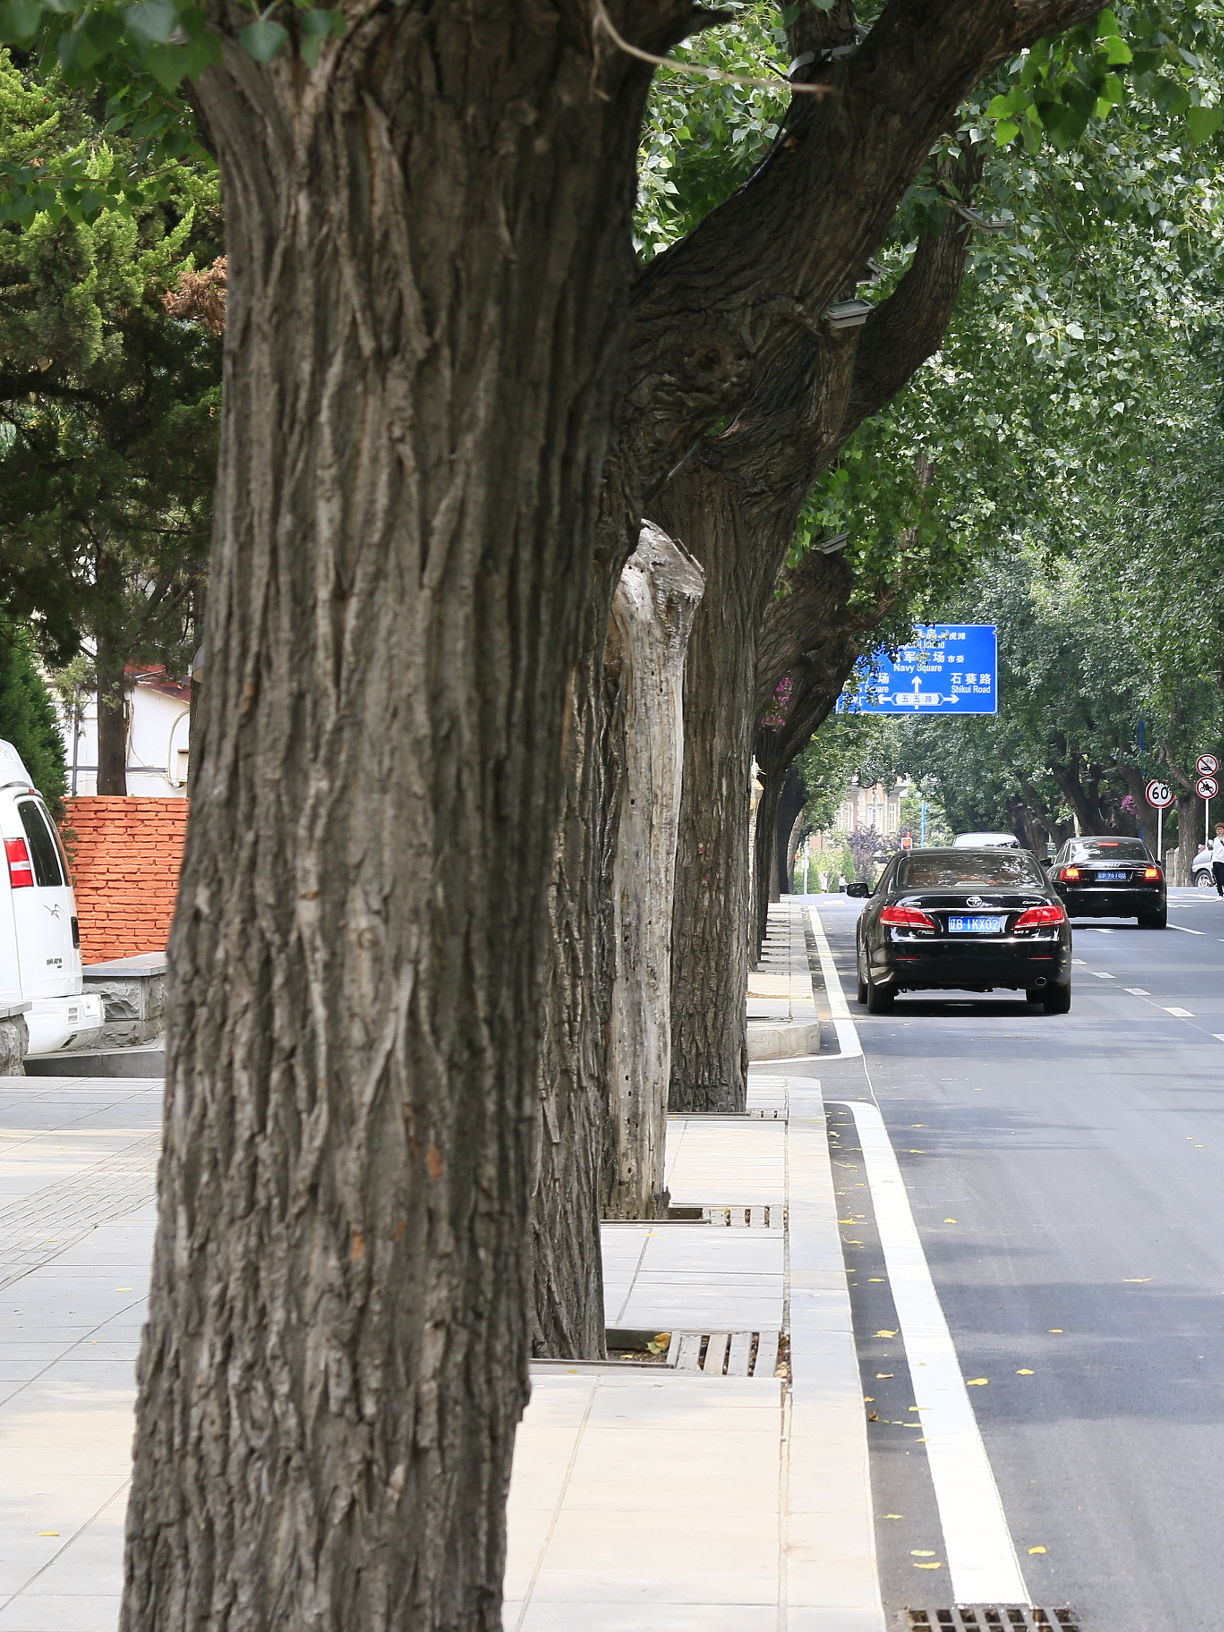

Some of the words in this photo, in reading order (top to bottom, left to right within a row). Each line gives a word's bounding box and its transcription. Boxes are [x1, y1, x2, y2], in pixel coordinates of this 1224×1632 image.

[893, 664, 915, 673] Navy
[917, 664, 942, 674] Square
[950, 672, 991, 685] 石葵路
[951, 684, 971, 694] Shikui
[973, 685, 991, 694] Road
[1152, 787, 1168, 799] 60
